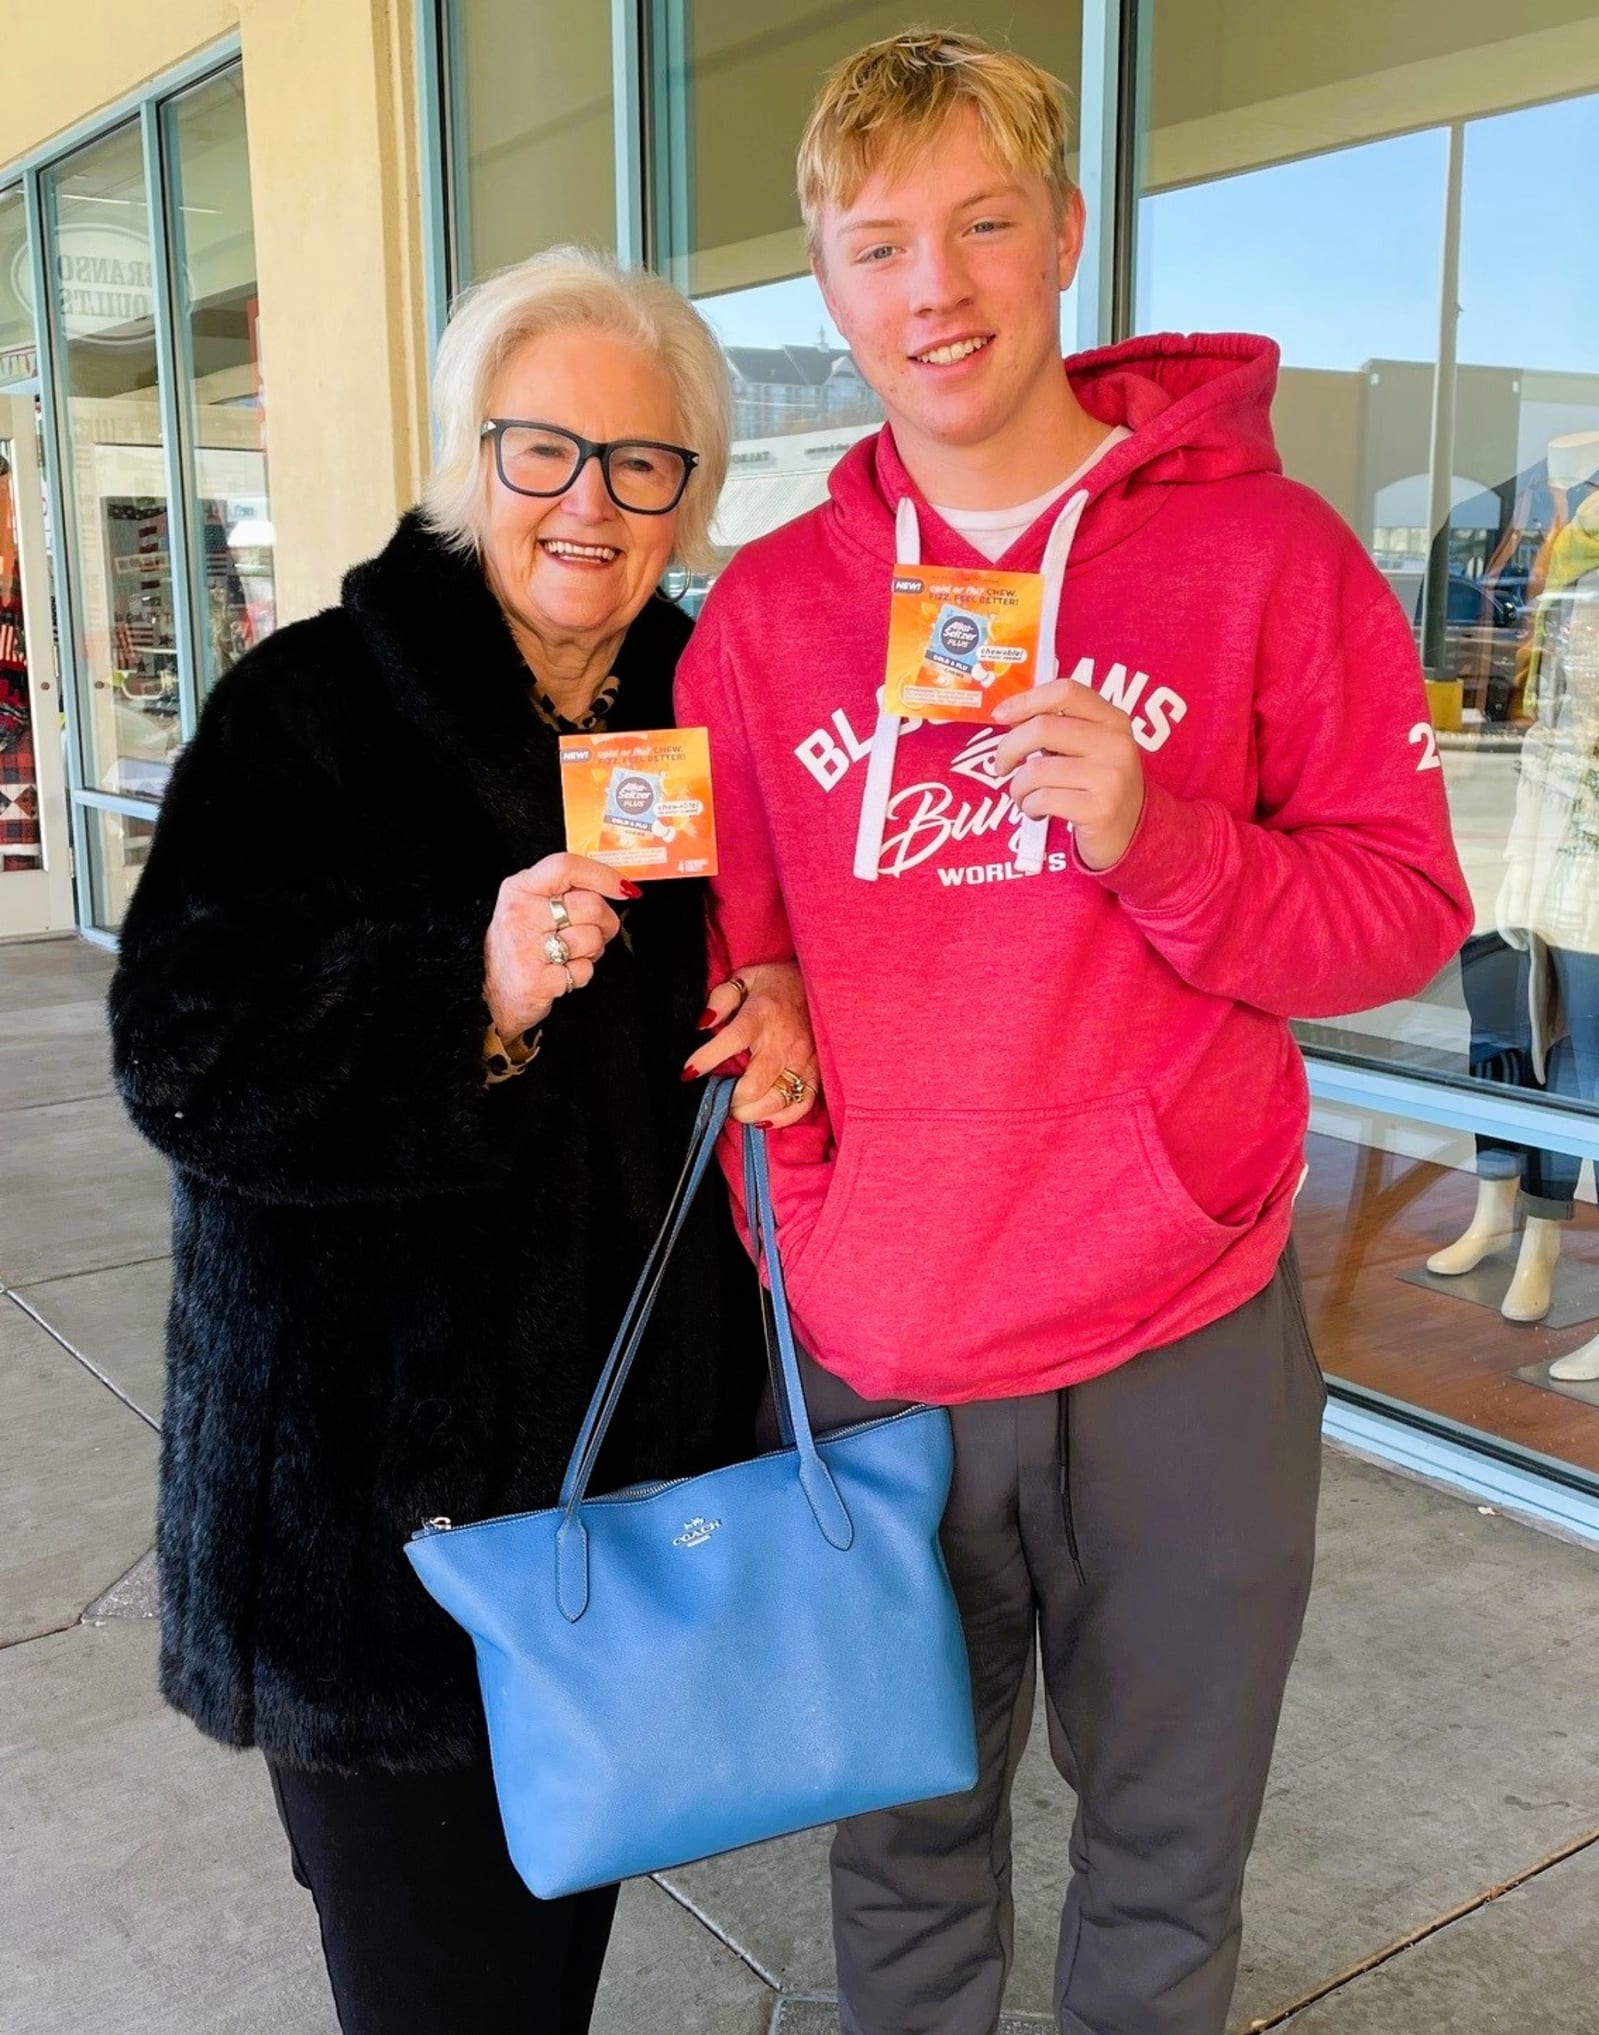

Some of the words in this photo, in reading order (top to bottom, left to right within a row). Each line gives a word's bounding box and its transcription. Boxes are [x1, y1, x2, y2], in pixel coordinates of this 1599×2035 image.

[895, 581, 922, 591] NEW!
[943, 627, 977, 641] Seltzer
[947, 638, 969, 648] PLUS
[955, 662, 968, 670] FLU
[563, 751, 589, 760] NEW!
[623, 800, 646, 808] PLUS
[673, 1520, 722, 1547] COACH
